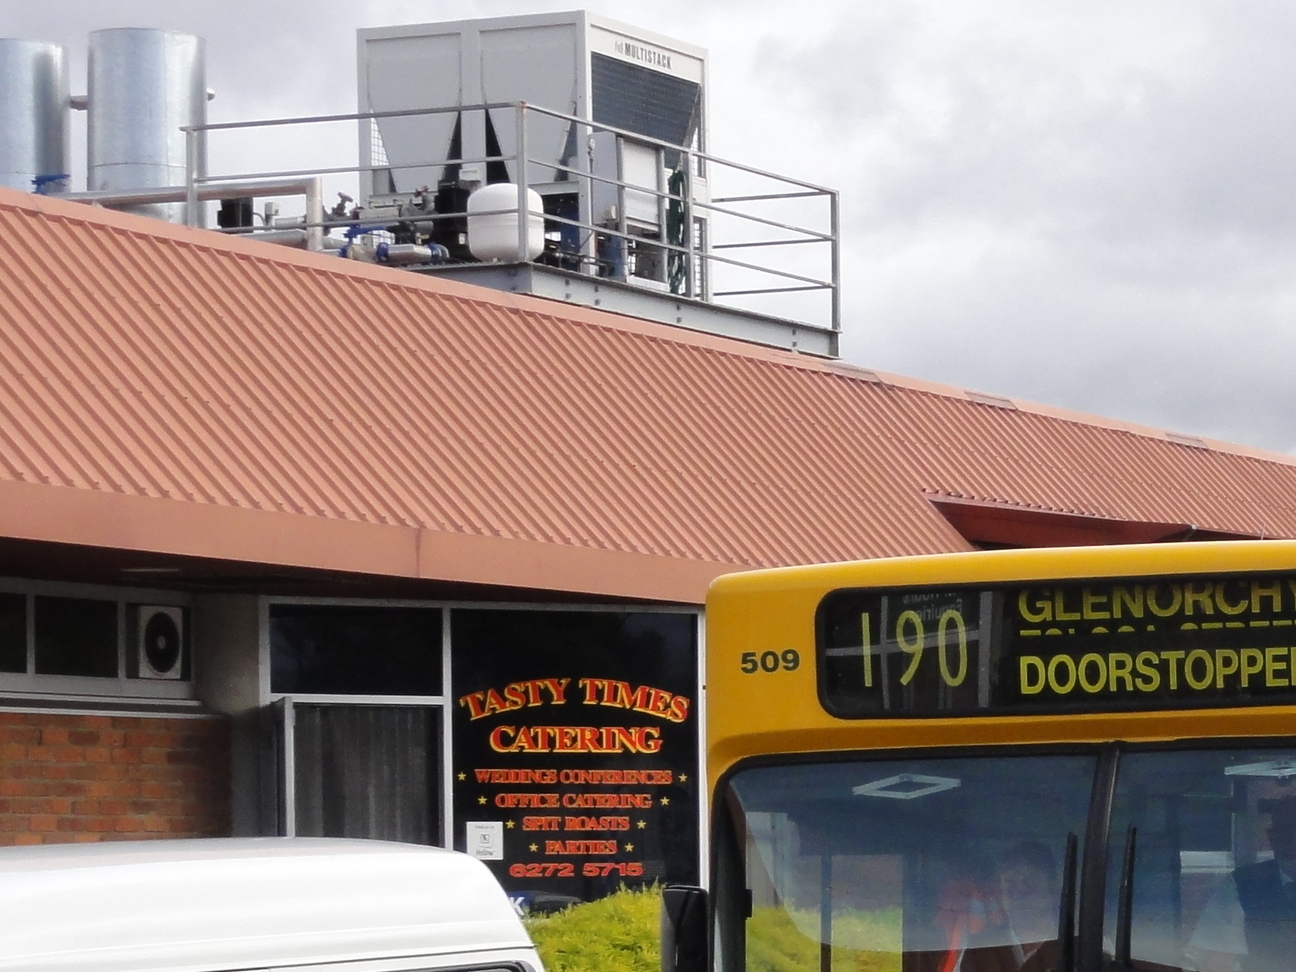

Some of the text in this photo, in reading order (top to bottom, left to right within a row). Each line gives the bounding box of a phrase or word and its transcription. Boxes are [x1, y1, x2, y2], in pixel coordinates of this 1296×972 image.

[624, 42, 672, 69] MULTISTACK
[861, 610, 968, 687] 190
[740, 648, 801, 675] 509
[459, 677, 690, 723] TASTY TIMES
[489, 726, 663, 754] CATERING
[474, 769, 673, 785] WEDDINGS CONFERENCES
[494, 793, 653, 809] OFFICE CATERING
[522, 816, 630, 831] SPIT ROASTS
[544, 840, 617, 855] PARTIES
[509, 863, 644, 877] 6272 5715
